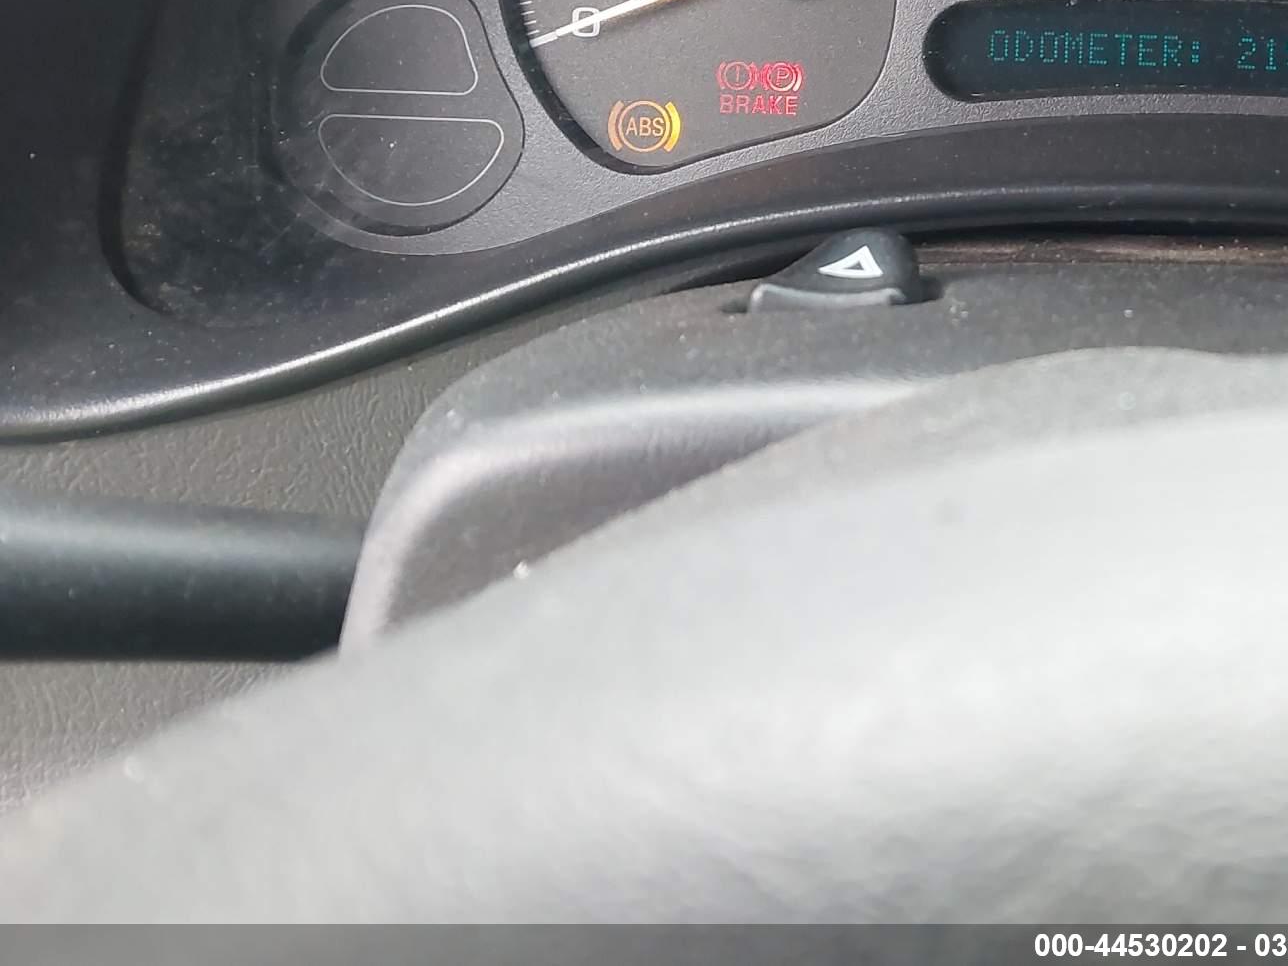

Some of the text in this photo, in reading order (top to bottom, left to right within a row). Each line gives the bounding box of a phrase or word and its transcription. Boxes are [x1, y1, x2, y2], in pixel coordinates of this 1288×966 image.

[987, 29, 1200, 68] ODOMETER:
[719, 94, 798, 115] BRAKE
[625, 117, 664, 136] ABS
